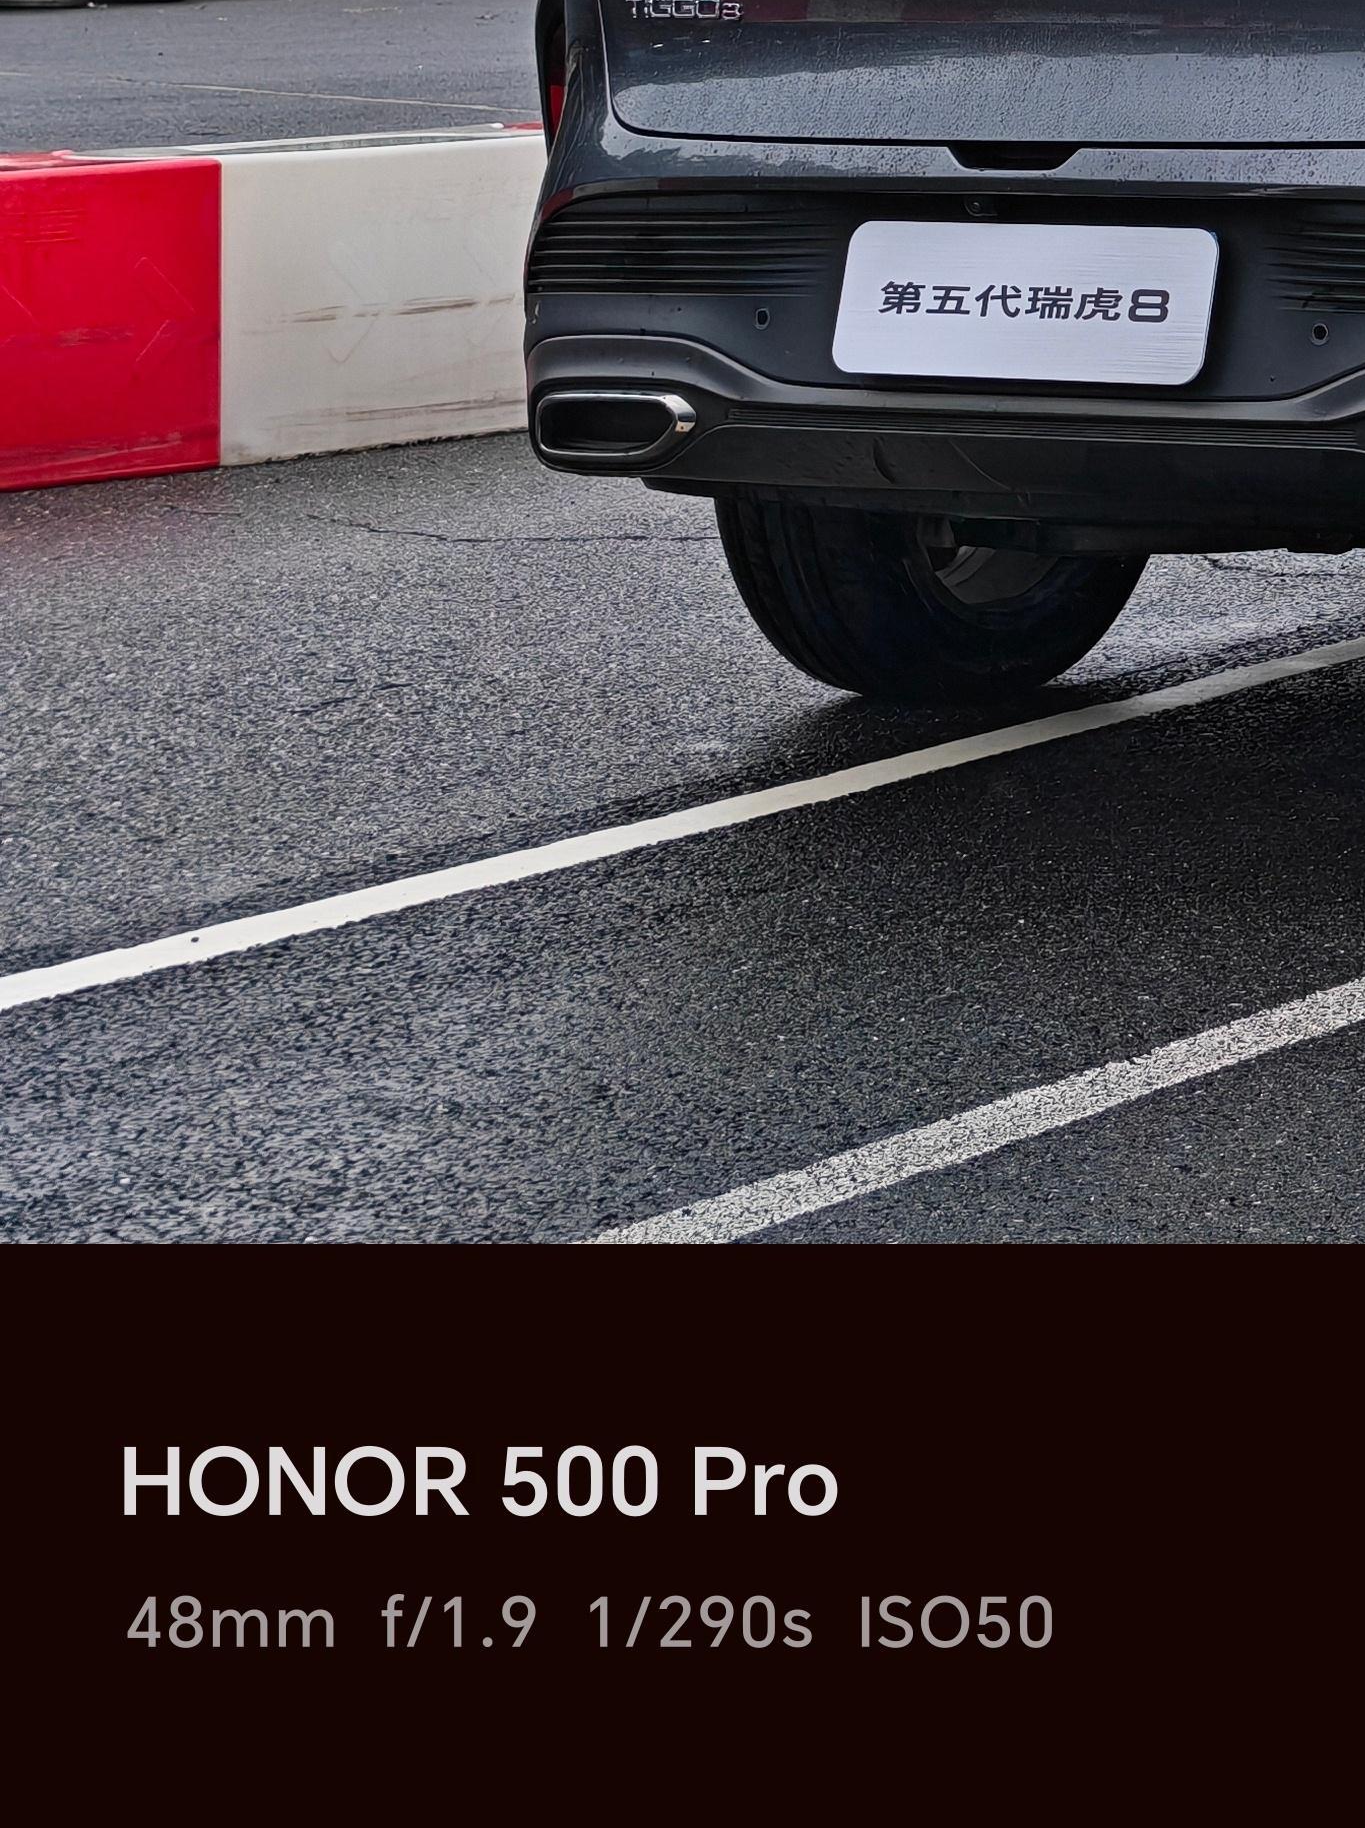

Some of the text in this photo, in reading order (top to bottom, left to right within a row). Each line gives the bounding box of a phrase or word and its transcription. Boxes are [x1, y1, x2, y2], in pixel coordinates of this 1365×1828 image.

[878, 280, 1170, 323] 第五代瑞虎8
